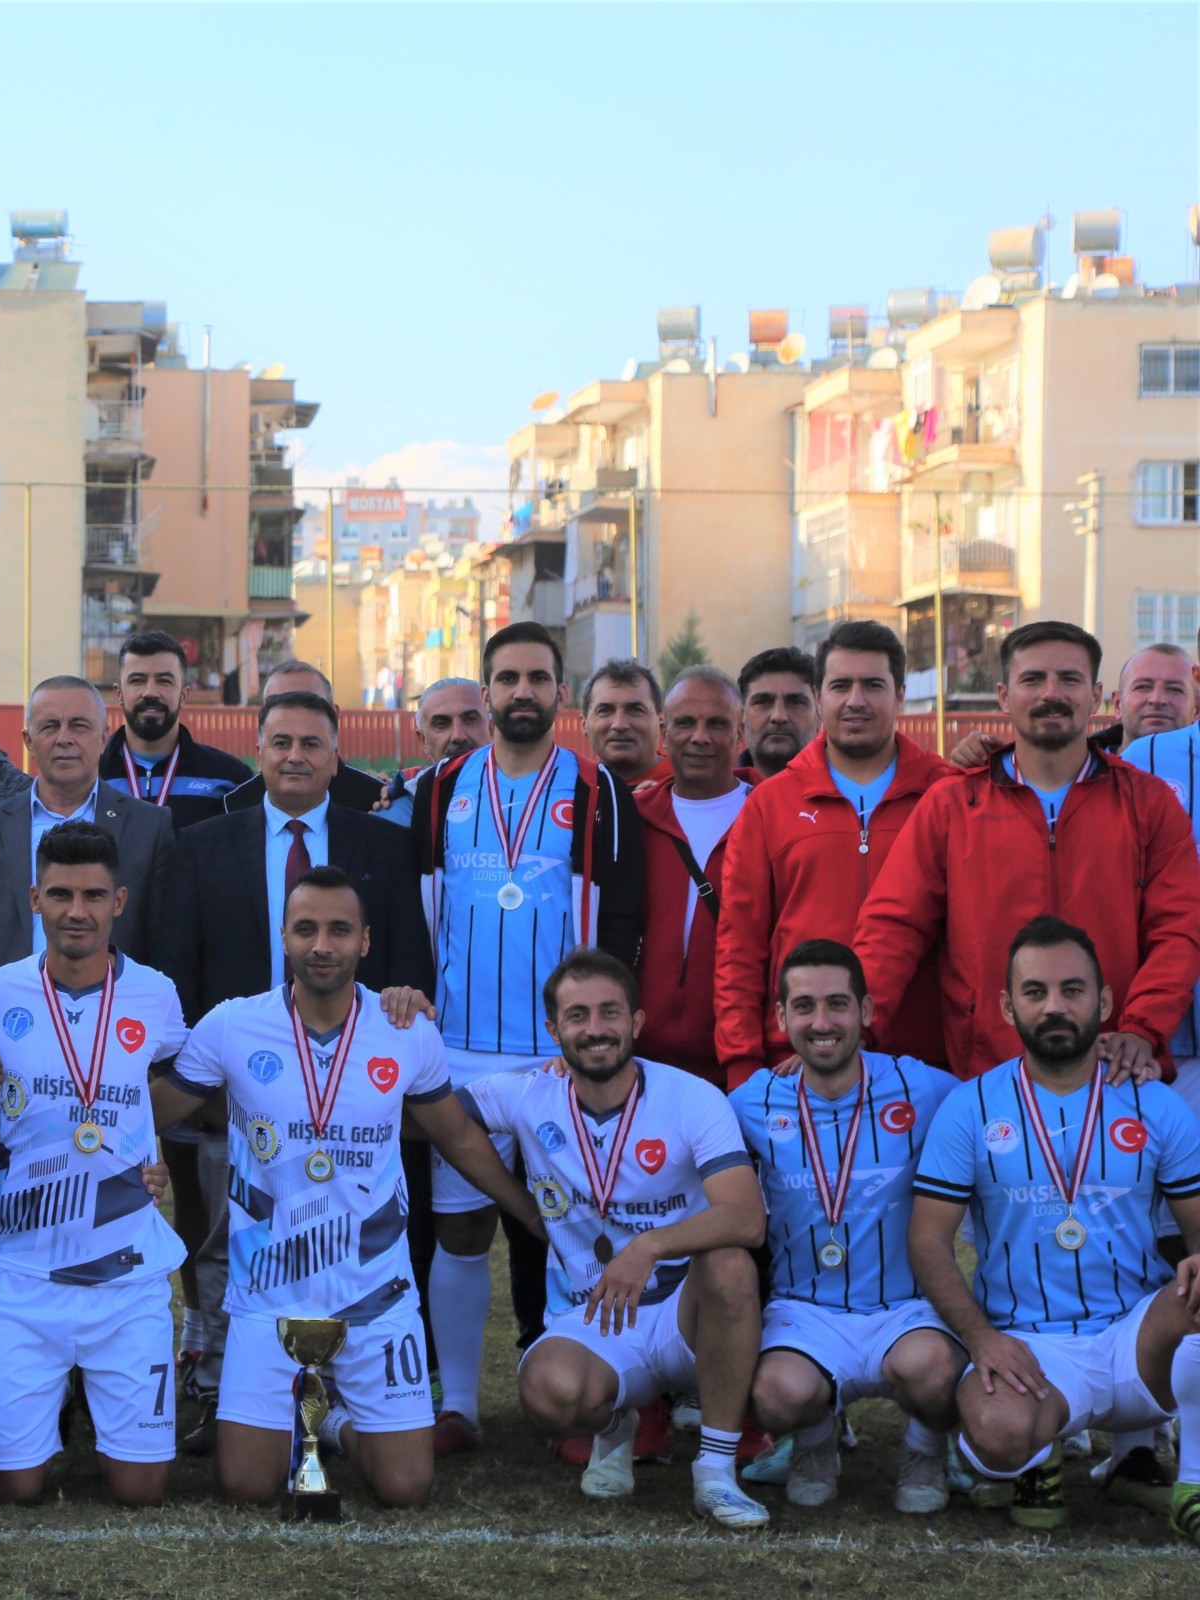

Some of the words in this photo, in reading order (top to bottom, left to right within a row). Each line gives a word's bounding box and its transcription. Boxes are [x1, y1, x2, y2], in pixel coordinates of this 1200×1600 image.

[625, 1193, 688, 1217] GELİŞİM
[381, 1333, 422, 1387] 10
[149, 1363, 169, 1416] 7
